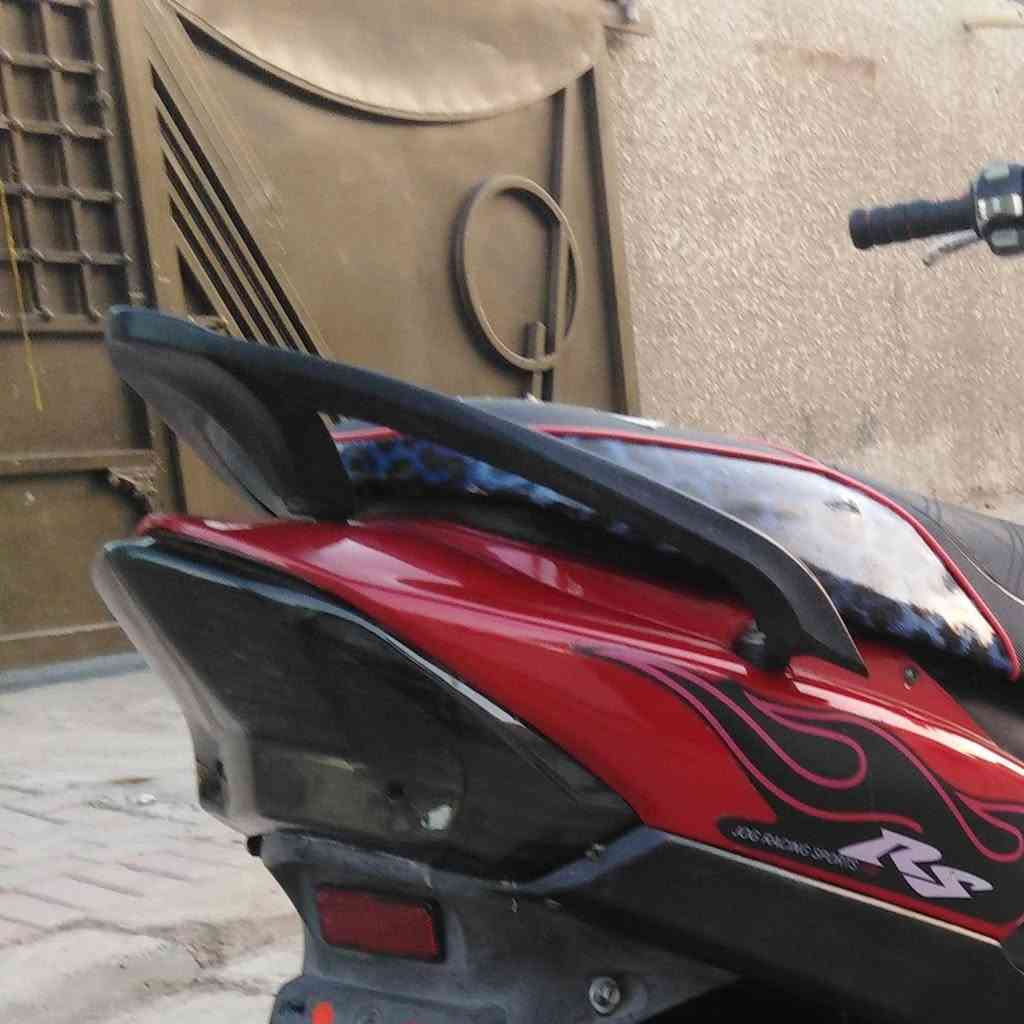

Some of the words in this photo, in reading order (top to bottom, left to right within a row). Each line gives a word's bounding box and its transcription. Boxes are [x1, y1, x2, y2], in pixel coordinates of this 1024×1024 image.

[730, 824, 761, 842] JOG
[760, 832, 811, 856] RACING
[809, 845, 860, 871] SPORTS
[838, 826, 993, 899] RS
